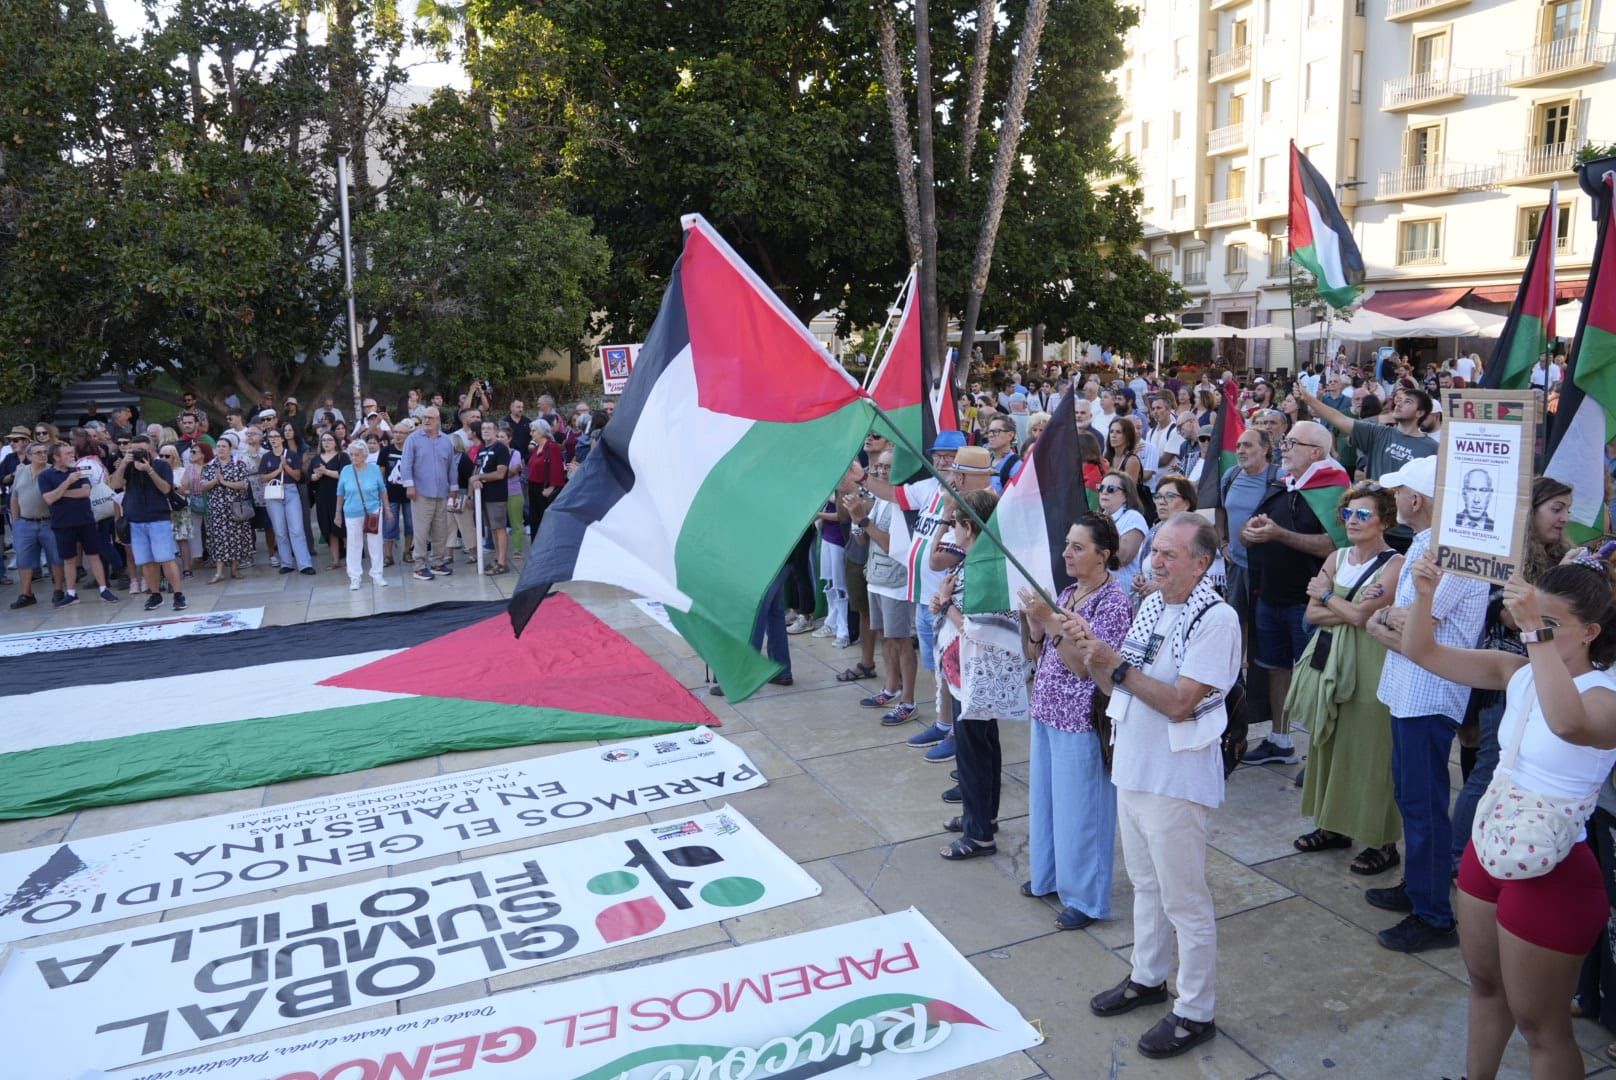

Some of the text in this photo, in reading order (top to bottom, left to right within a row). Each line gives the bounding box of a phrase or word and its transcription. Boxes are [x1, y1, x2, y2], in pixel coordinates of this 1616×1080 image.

[1456, 440, 1510, 455] WANTED
[463, 776, 493, 786] LAS
[496, 781, 567, 806] EN
[347, 783, 458, 808] RELACIONES
[516, 763, 758, 827] PAREMOS
[250, 781, 516, 835] FIN AL COMERCIO DE ARMAS
[297, 805, 340, 818] CON
[174, 797, 479, 866] PALESTINA
[226, 814, 288, 830] ISRAEL
[443, 818, 501, 841] EL
[21, 834, 424, 924] GENOCIDIO
[36, 860, 548, 989] FLOTILLA
[194, 891, 562, 993] SUMUD
[95, 924, 579, 1056] GLOBAL
[265, 942, 920, 1080] PAREMOS EL GENO
[423, 1016, 440, 1029] el
[444, 1005, 496, 1019] Desde
[319, 1037, 338, 1049] el
[342, 1026, 392, 1042] hasta
[176, 1050, 269, 1077] Palestina
